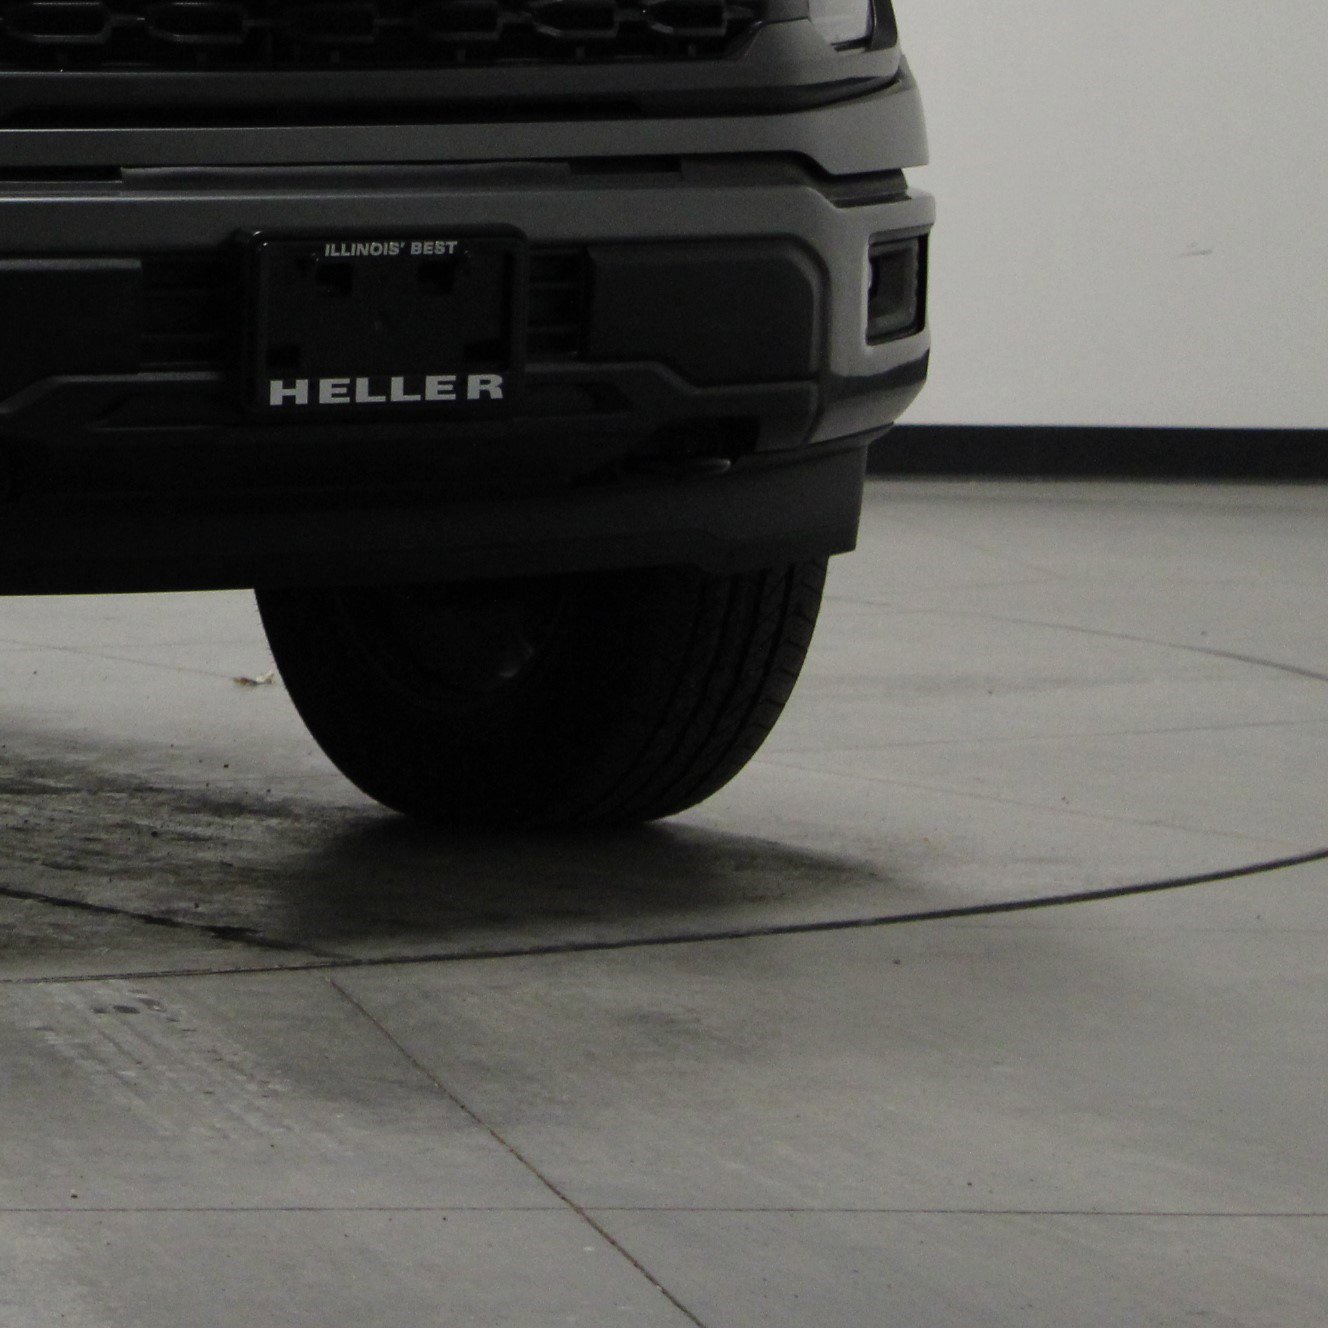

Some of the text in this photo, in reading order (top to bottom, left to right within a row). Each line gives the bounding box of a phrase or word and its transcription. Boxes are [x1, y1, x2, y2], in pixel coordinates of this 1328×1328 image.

[325, 240, 458, 257] ILLINOIS' BEST
[270, 374, 504, 406] HELLER
